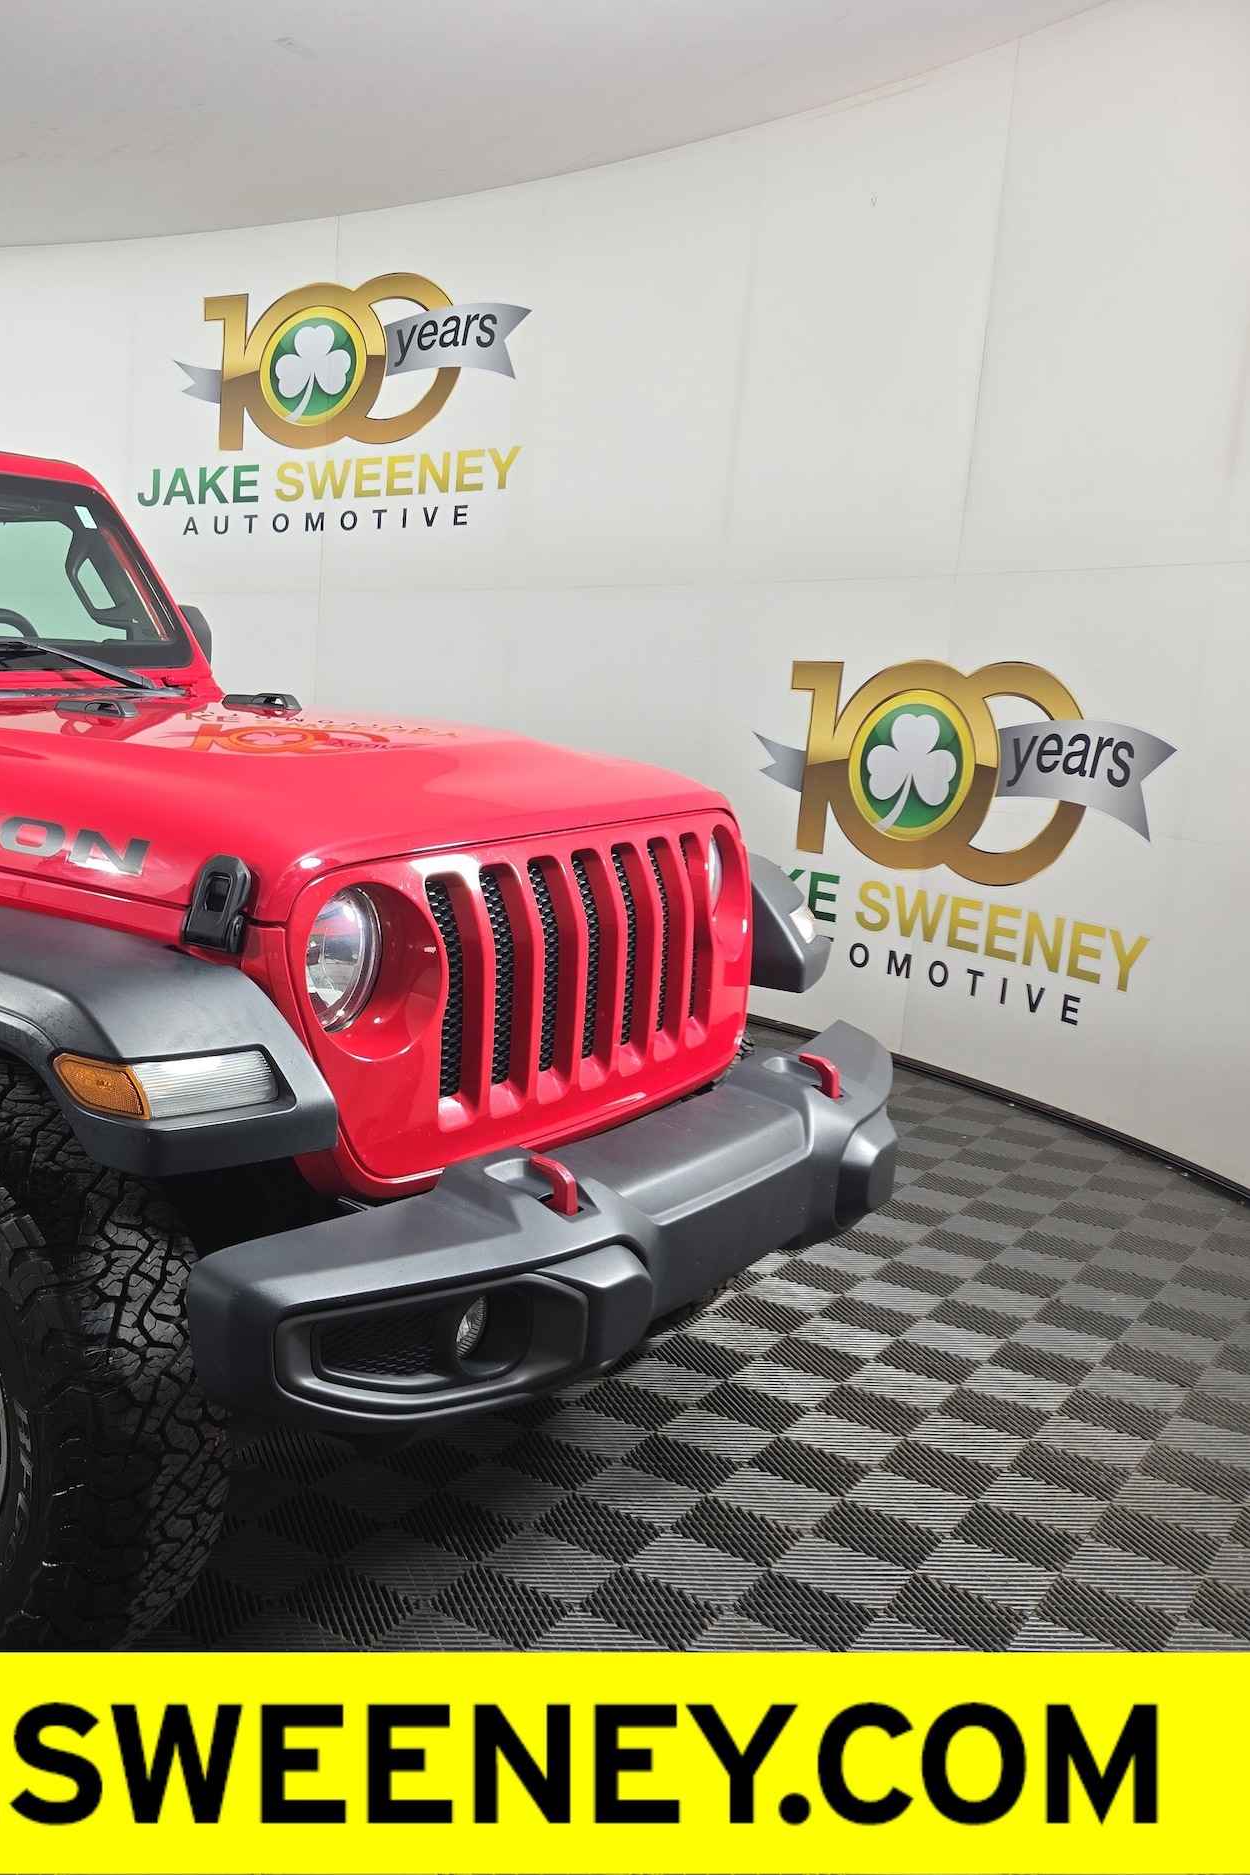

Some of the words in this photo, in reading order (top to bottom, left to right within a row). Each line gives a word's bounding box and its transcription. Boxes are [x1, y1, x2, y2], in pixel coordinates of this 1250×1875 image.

[203, 272, 462, 451] 100
[393, 312, 499, 368] years
[137, 464, 260, 507] JAKE
[274, 446, 522, 502] SWEENEY
[182, 504, 469, 536] AUTOMOTIVE
[790, 659, 1088, 886] 100
[1005, 732, 1136, 788] years
[823, 935, 1082, 1026] OMOTIVE
[855, 880, 1151, 993] SWEENEY
